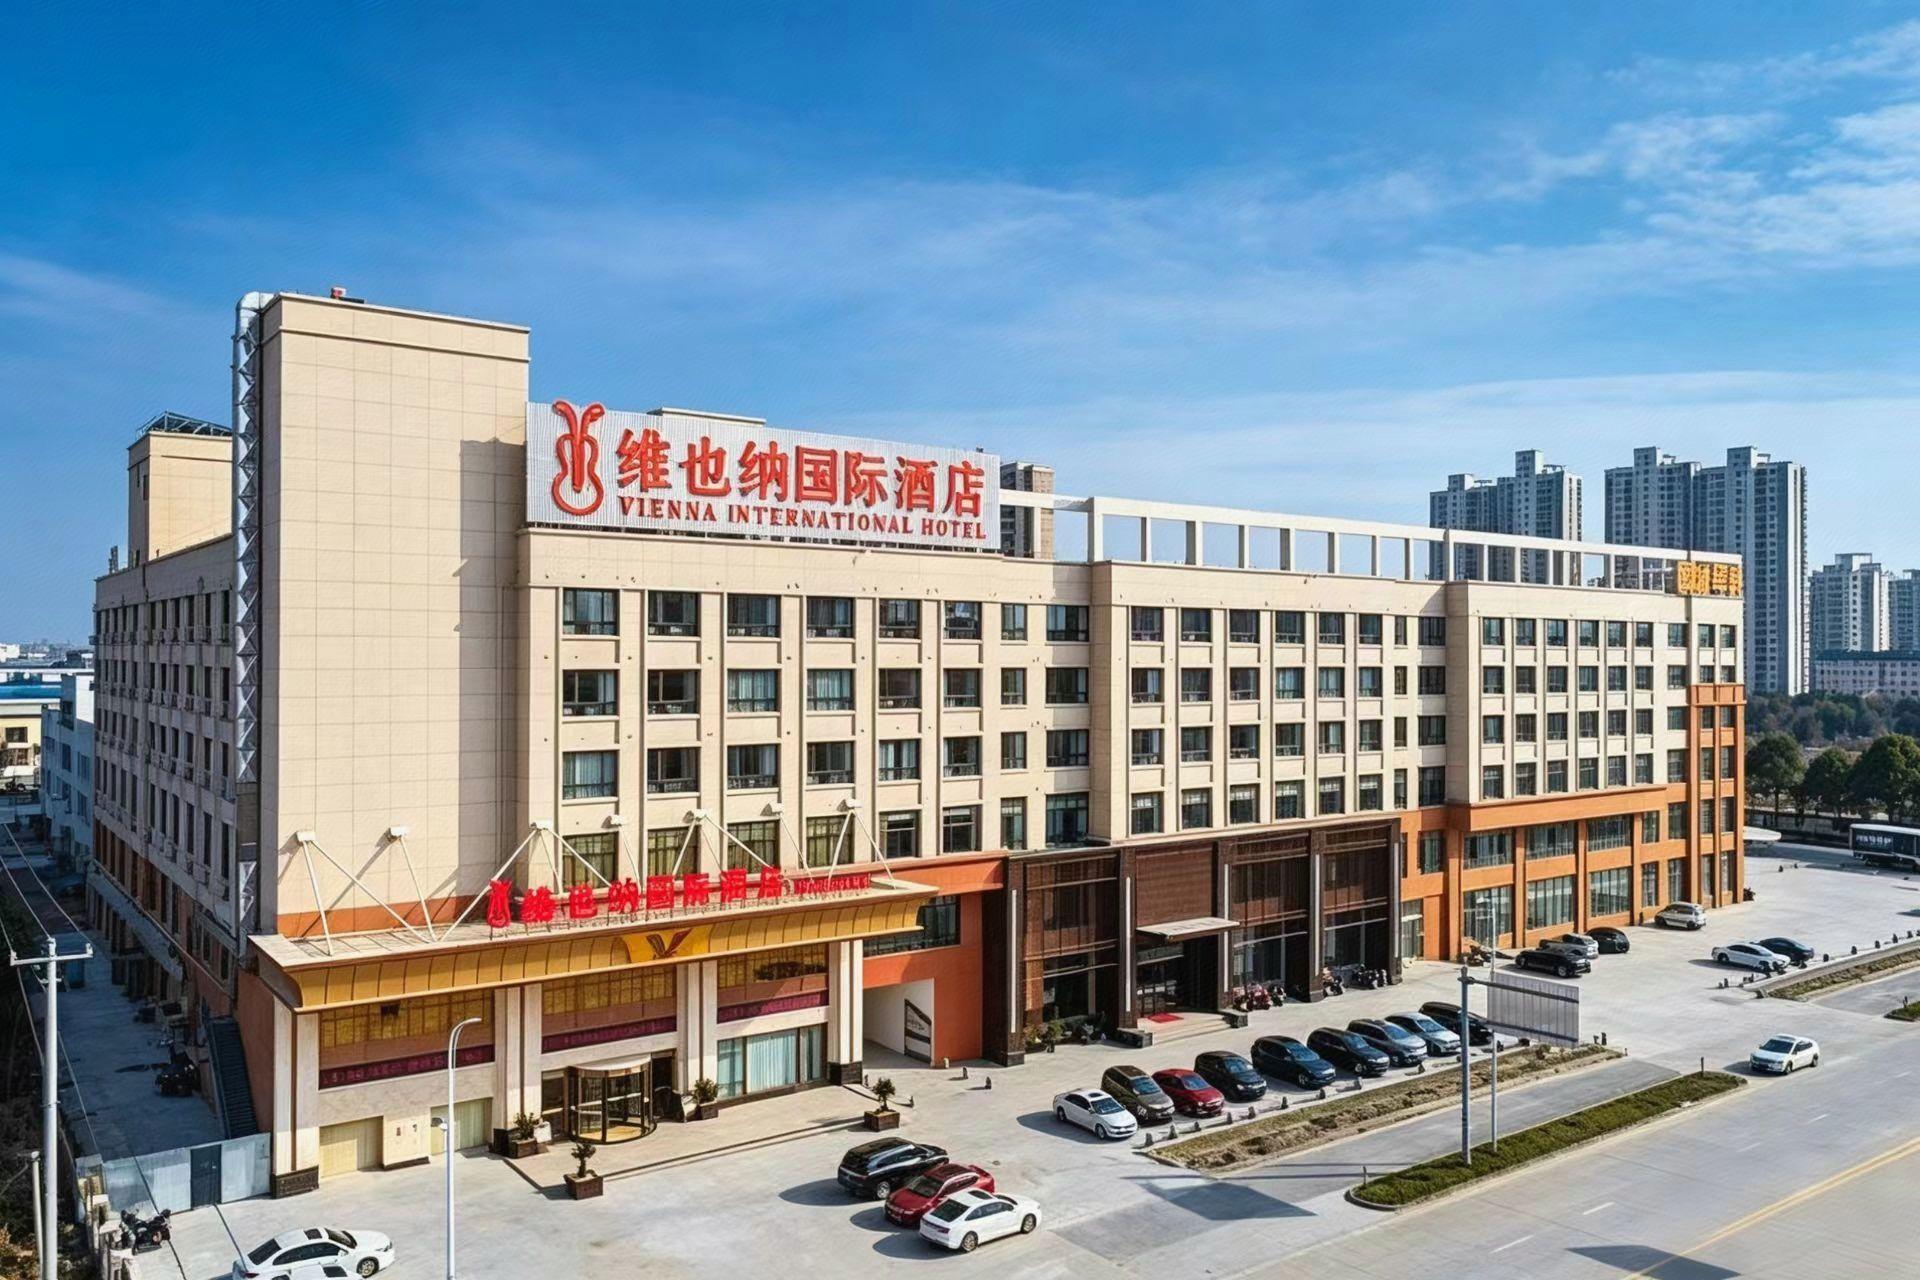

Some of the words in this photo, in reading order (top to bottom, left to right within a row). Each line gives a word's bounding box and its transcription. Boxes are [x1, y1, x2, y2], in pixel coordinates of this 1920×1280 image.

[616, 428, 984, 518] 维也纳国际酒店
[617, 495, 717, 521] VIENNA
[728, 504, 913, 534] INTERNATIONAL
[921, 517, 986, 539] HOTEL
